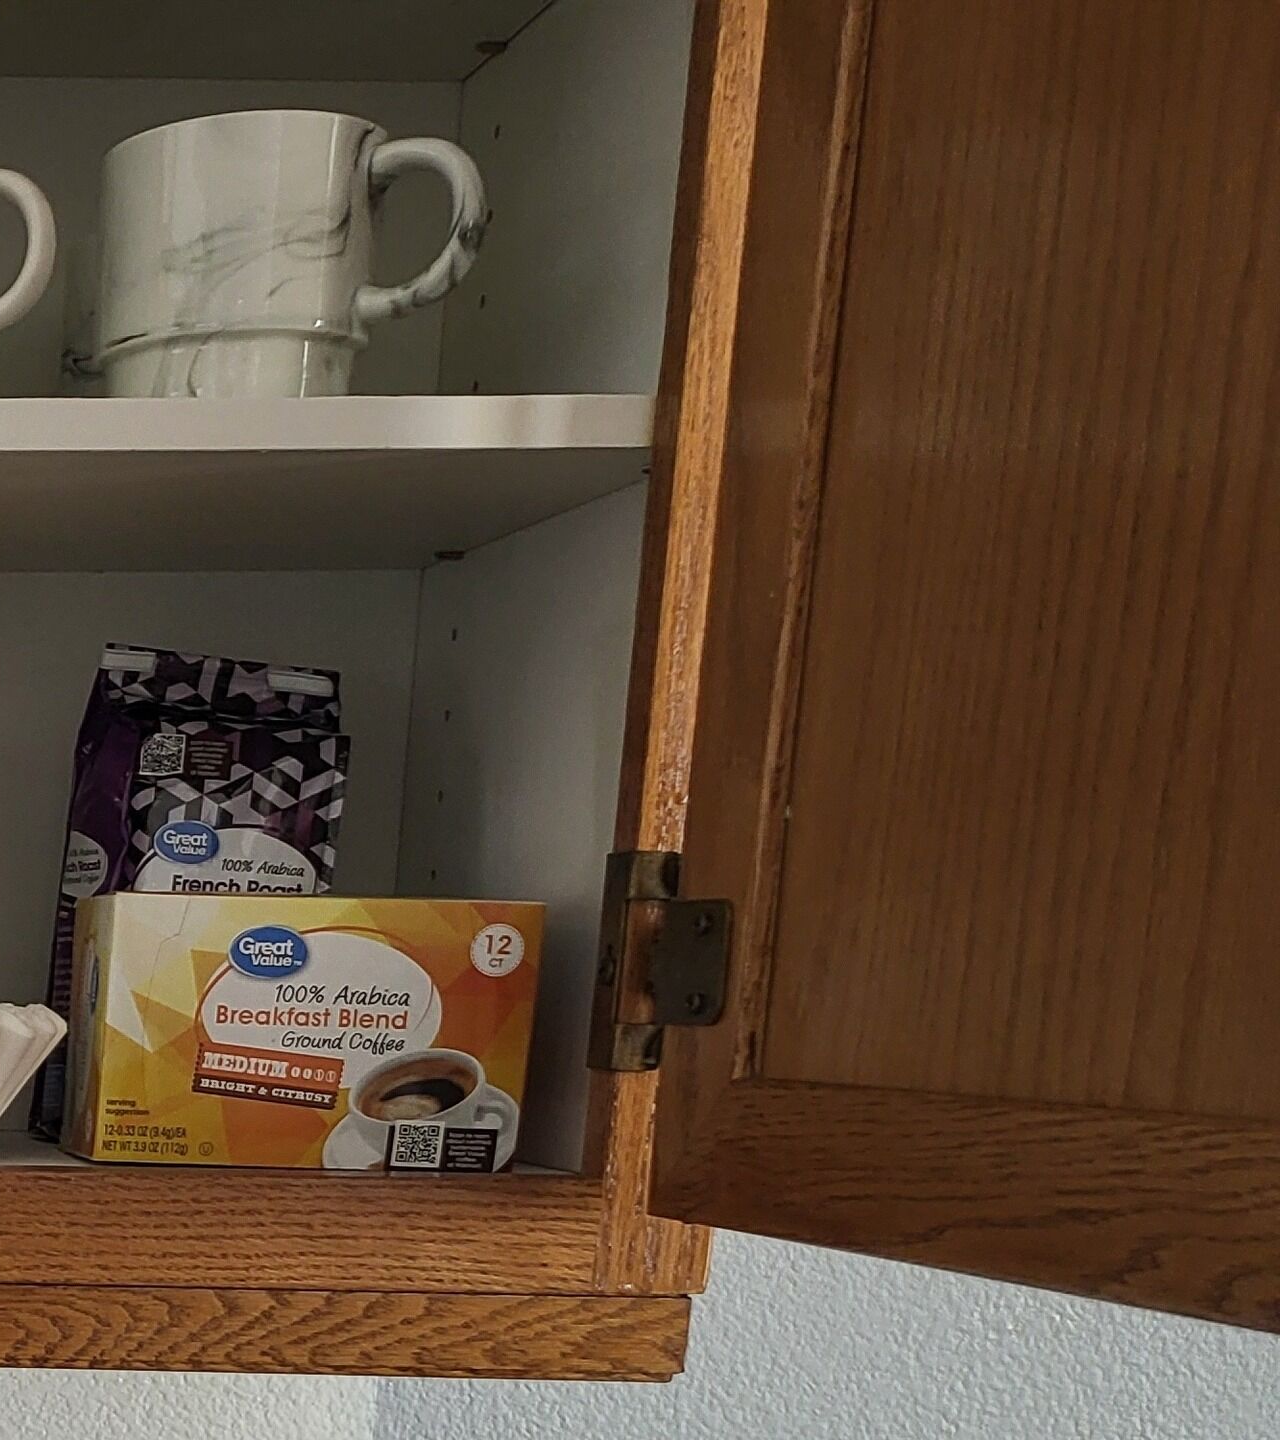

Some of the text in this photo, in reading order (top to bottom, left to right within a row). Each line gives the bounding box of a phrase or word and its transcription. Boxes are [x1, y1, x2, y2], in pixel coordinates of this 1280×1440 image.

[163, 830, 208, 847] Great
[173, 843, 206, 856] Value
[221, 858, 305, 877] 100% Arabica
[172, 875, 240, 892] French
[239, 937, 294, 956] Great
[485, 934, 512, 955] 12
[251, 953, 292, 967] Value
[488, 957, 504, 968] CT
[275, 984, 410, 1007] 100% Arabica
[215, 1005, 408, 1031] Breakfast Blend
[281, 1030, 405, 1055] Ground Coffee
[201, 1051, 290, 1079] MEDIUM
[199, 1078, 333, 1103] BRIGHT & CITRUSY
